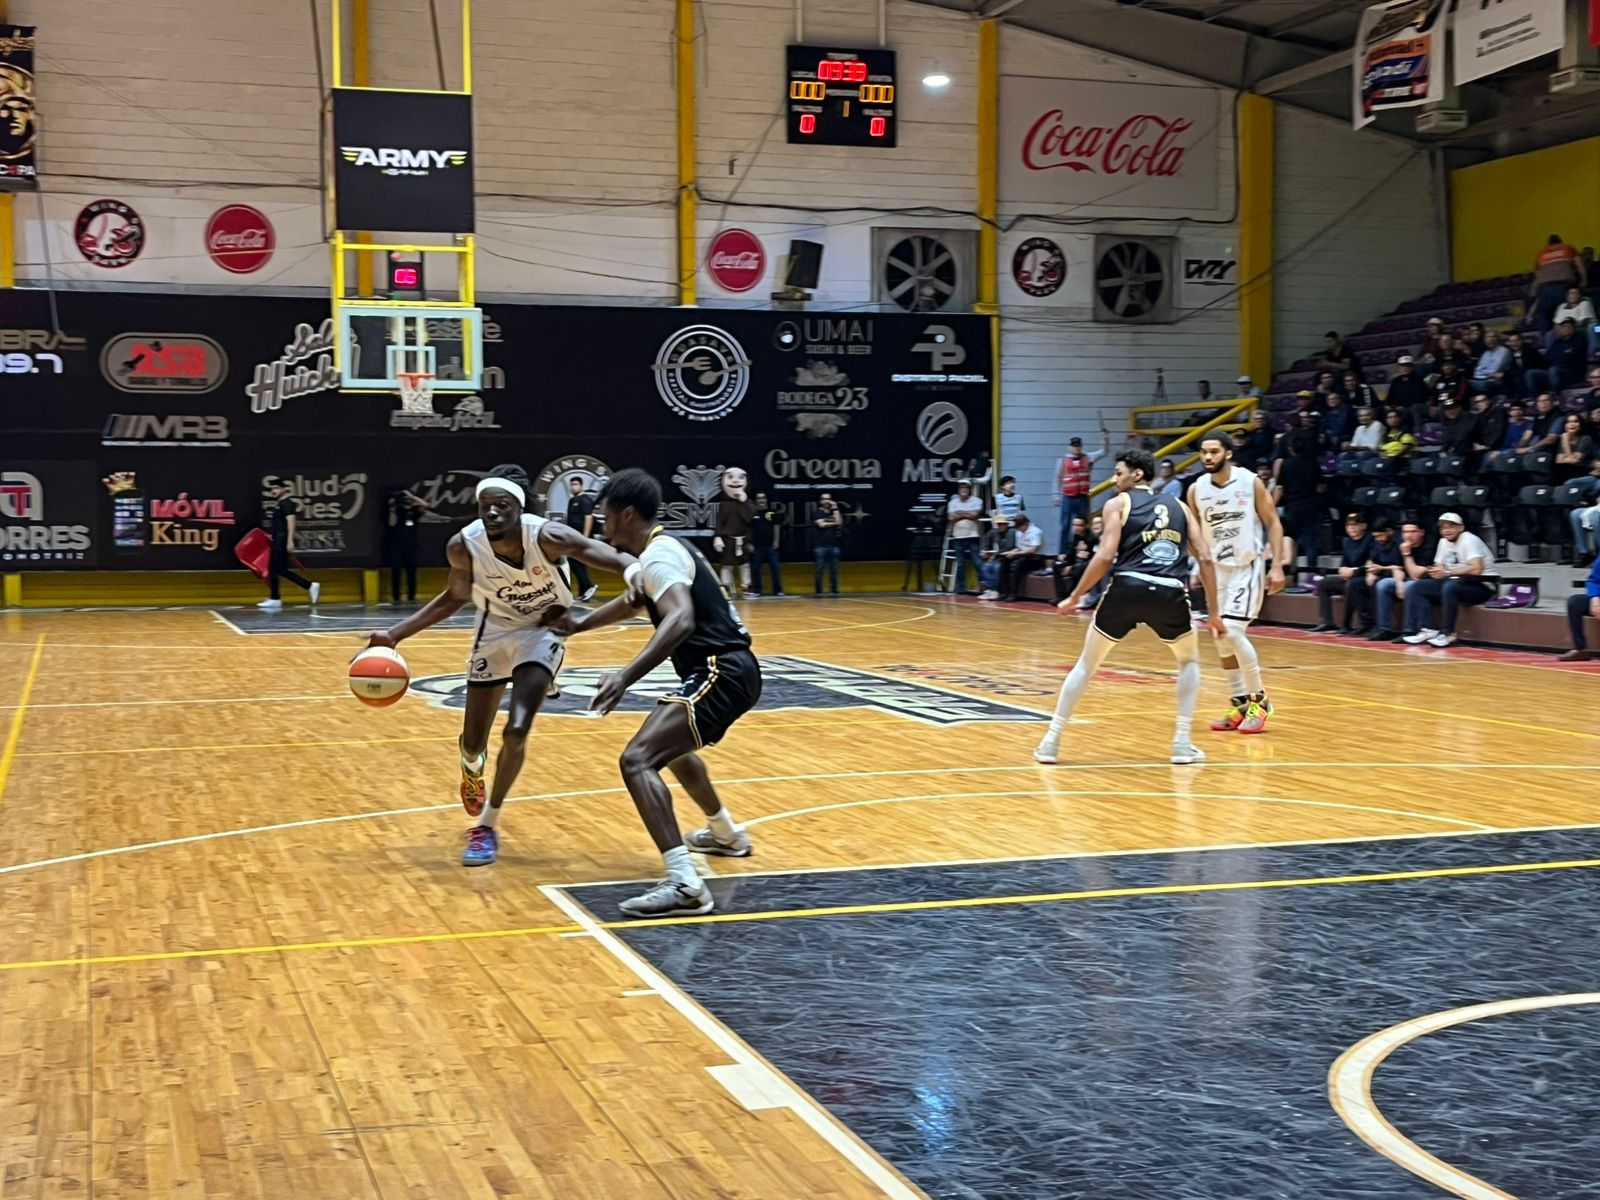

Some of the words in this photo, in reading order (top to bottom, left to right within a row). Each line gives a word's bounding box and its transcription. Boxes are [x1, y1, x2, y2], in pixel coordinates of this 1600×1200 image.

[799, 114, 816, 133] 0
[869, 117, 886, 136] 0
[346, 147, 460, 168] ARMY
[804, 319, 873, 342] UMAI
[0, 353, 64, 374] 9.7
[777, 391, 836, 405] BODEGA
[835, 386, 869, 410] 23
[763, 448, 883, 480] Greena
[261, 474, 339, 498] Salud
[1153, 503, 1170, 529] 3
[150, 520, 221, 551] King
[1232, 588, 1245, 604] 2
